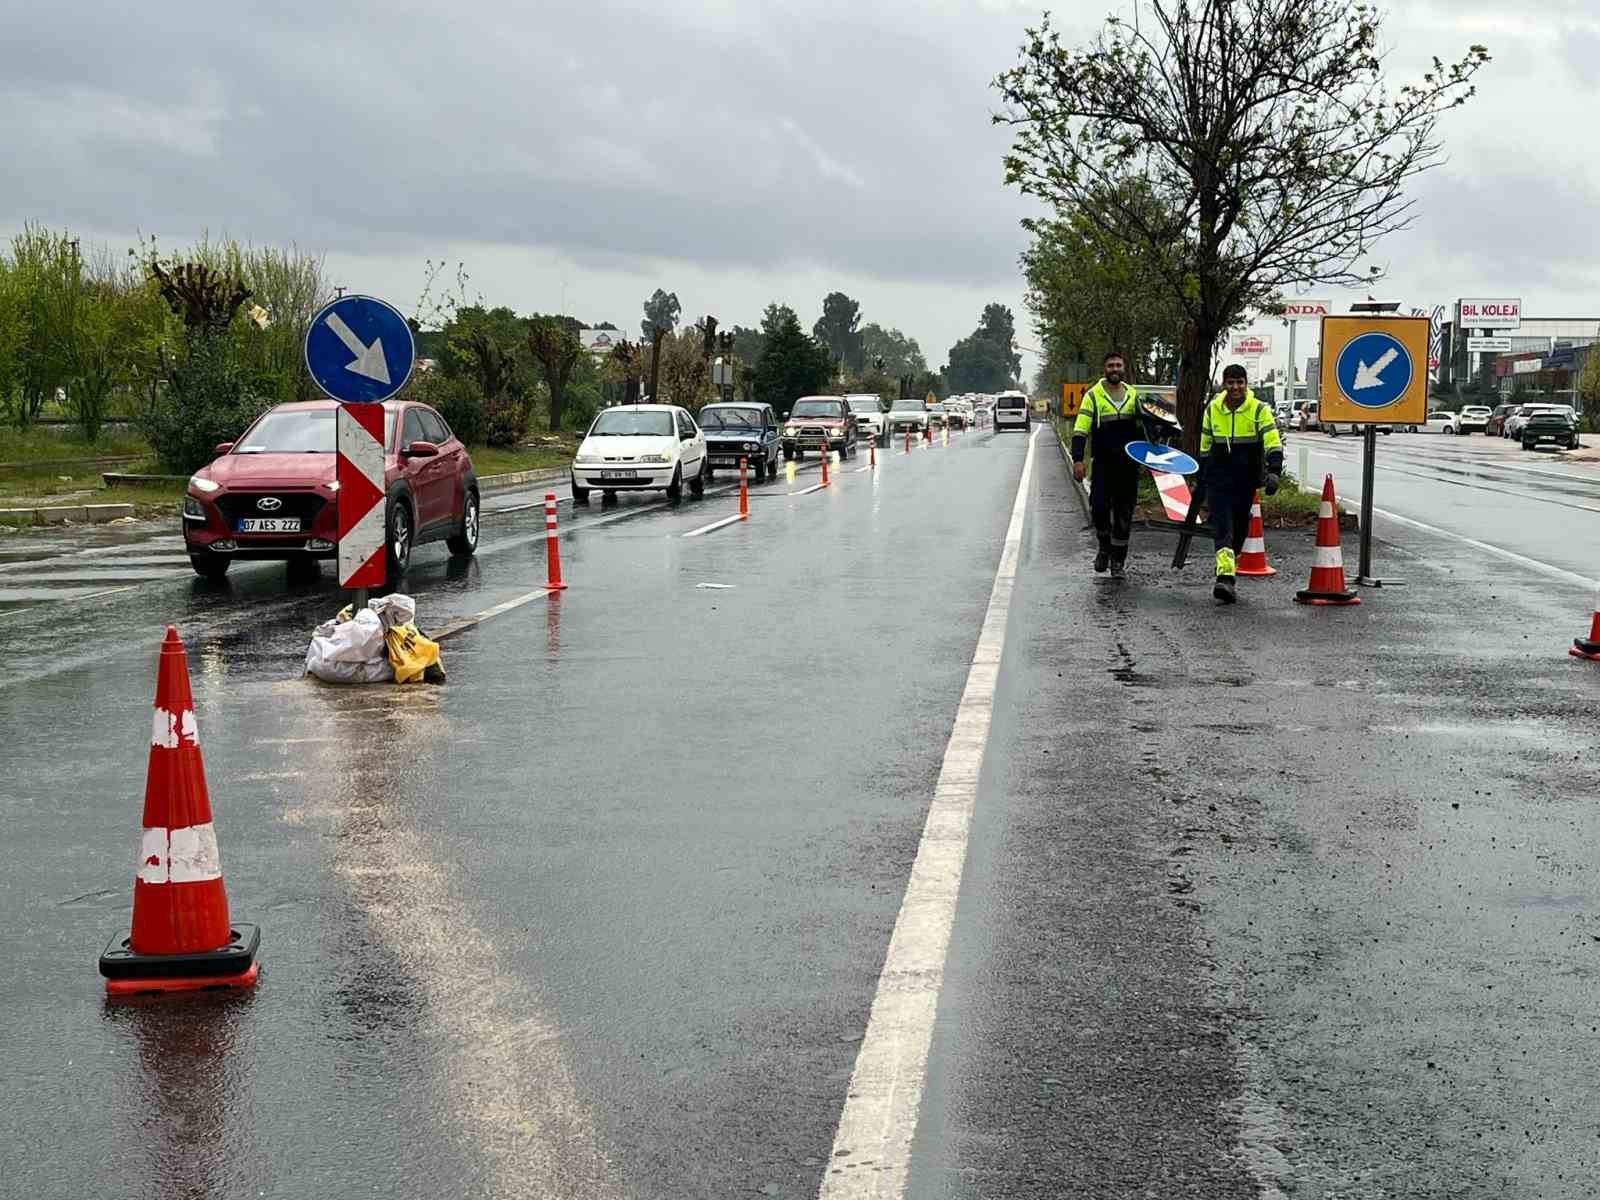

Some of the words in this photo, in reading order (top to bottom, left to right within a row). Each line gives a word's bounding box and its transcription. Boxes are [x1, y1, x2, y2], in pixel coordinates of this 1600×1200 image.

[245, 520, 255, 530] 07
[259, 520, 276, 530] AES
[282, 520, 299, 530] 222
